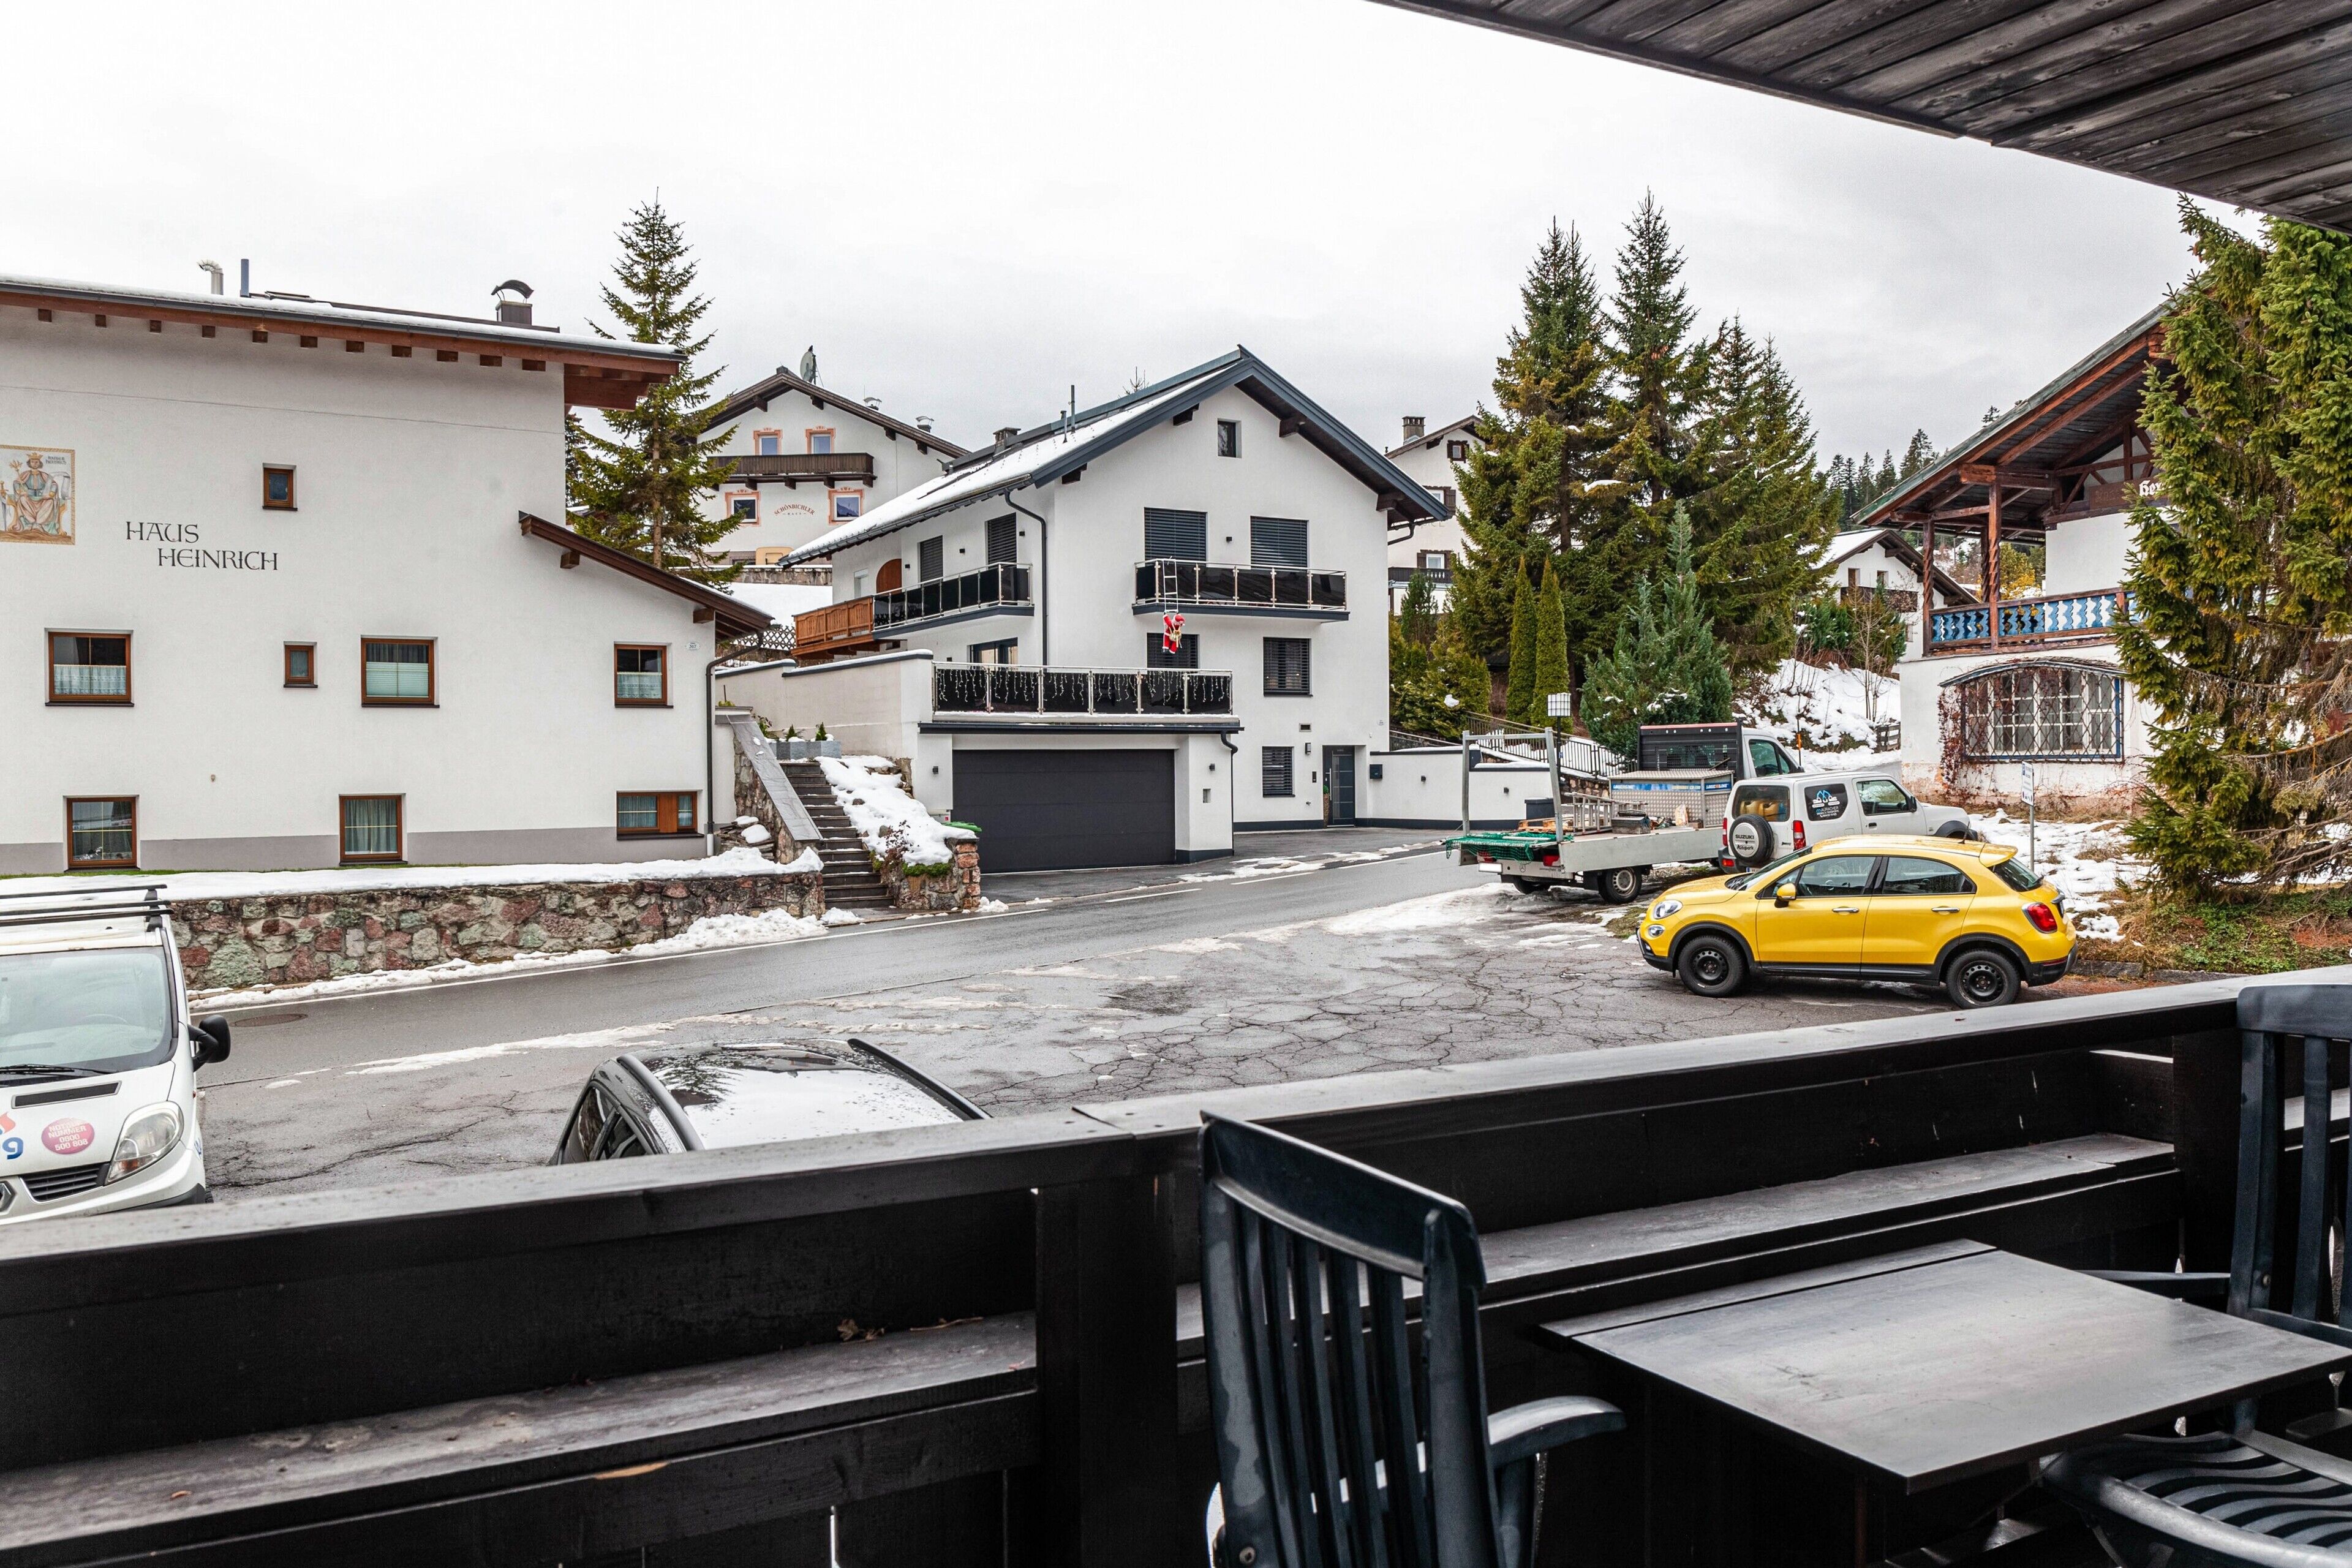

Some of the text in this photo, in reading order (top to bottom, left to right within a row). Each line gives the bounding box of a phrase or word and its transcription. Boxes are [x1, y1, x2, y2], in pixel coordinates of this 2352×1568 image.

[126, 521, 200, 543] HAUS
[157, 548, 278, 570] HEINRICH
[48, 1125, 87, 1138] NUMMER
[55, 1139, 88, 1151] 500 808
